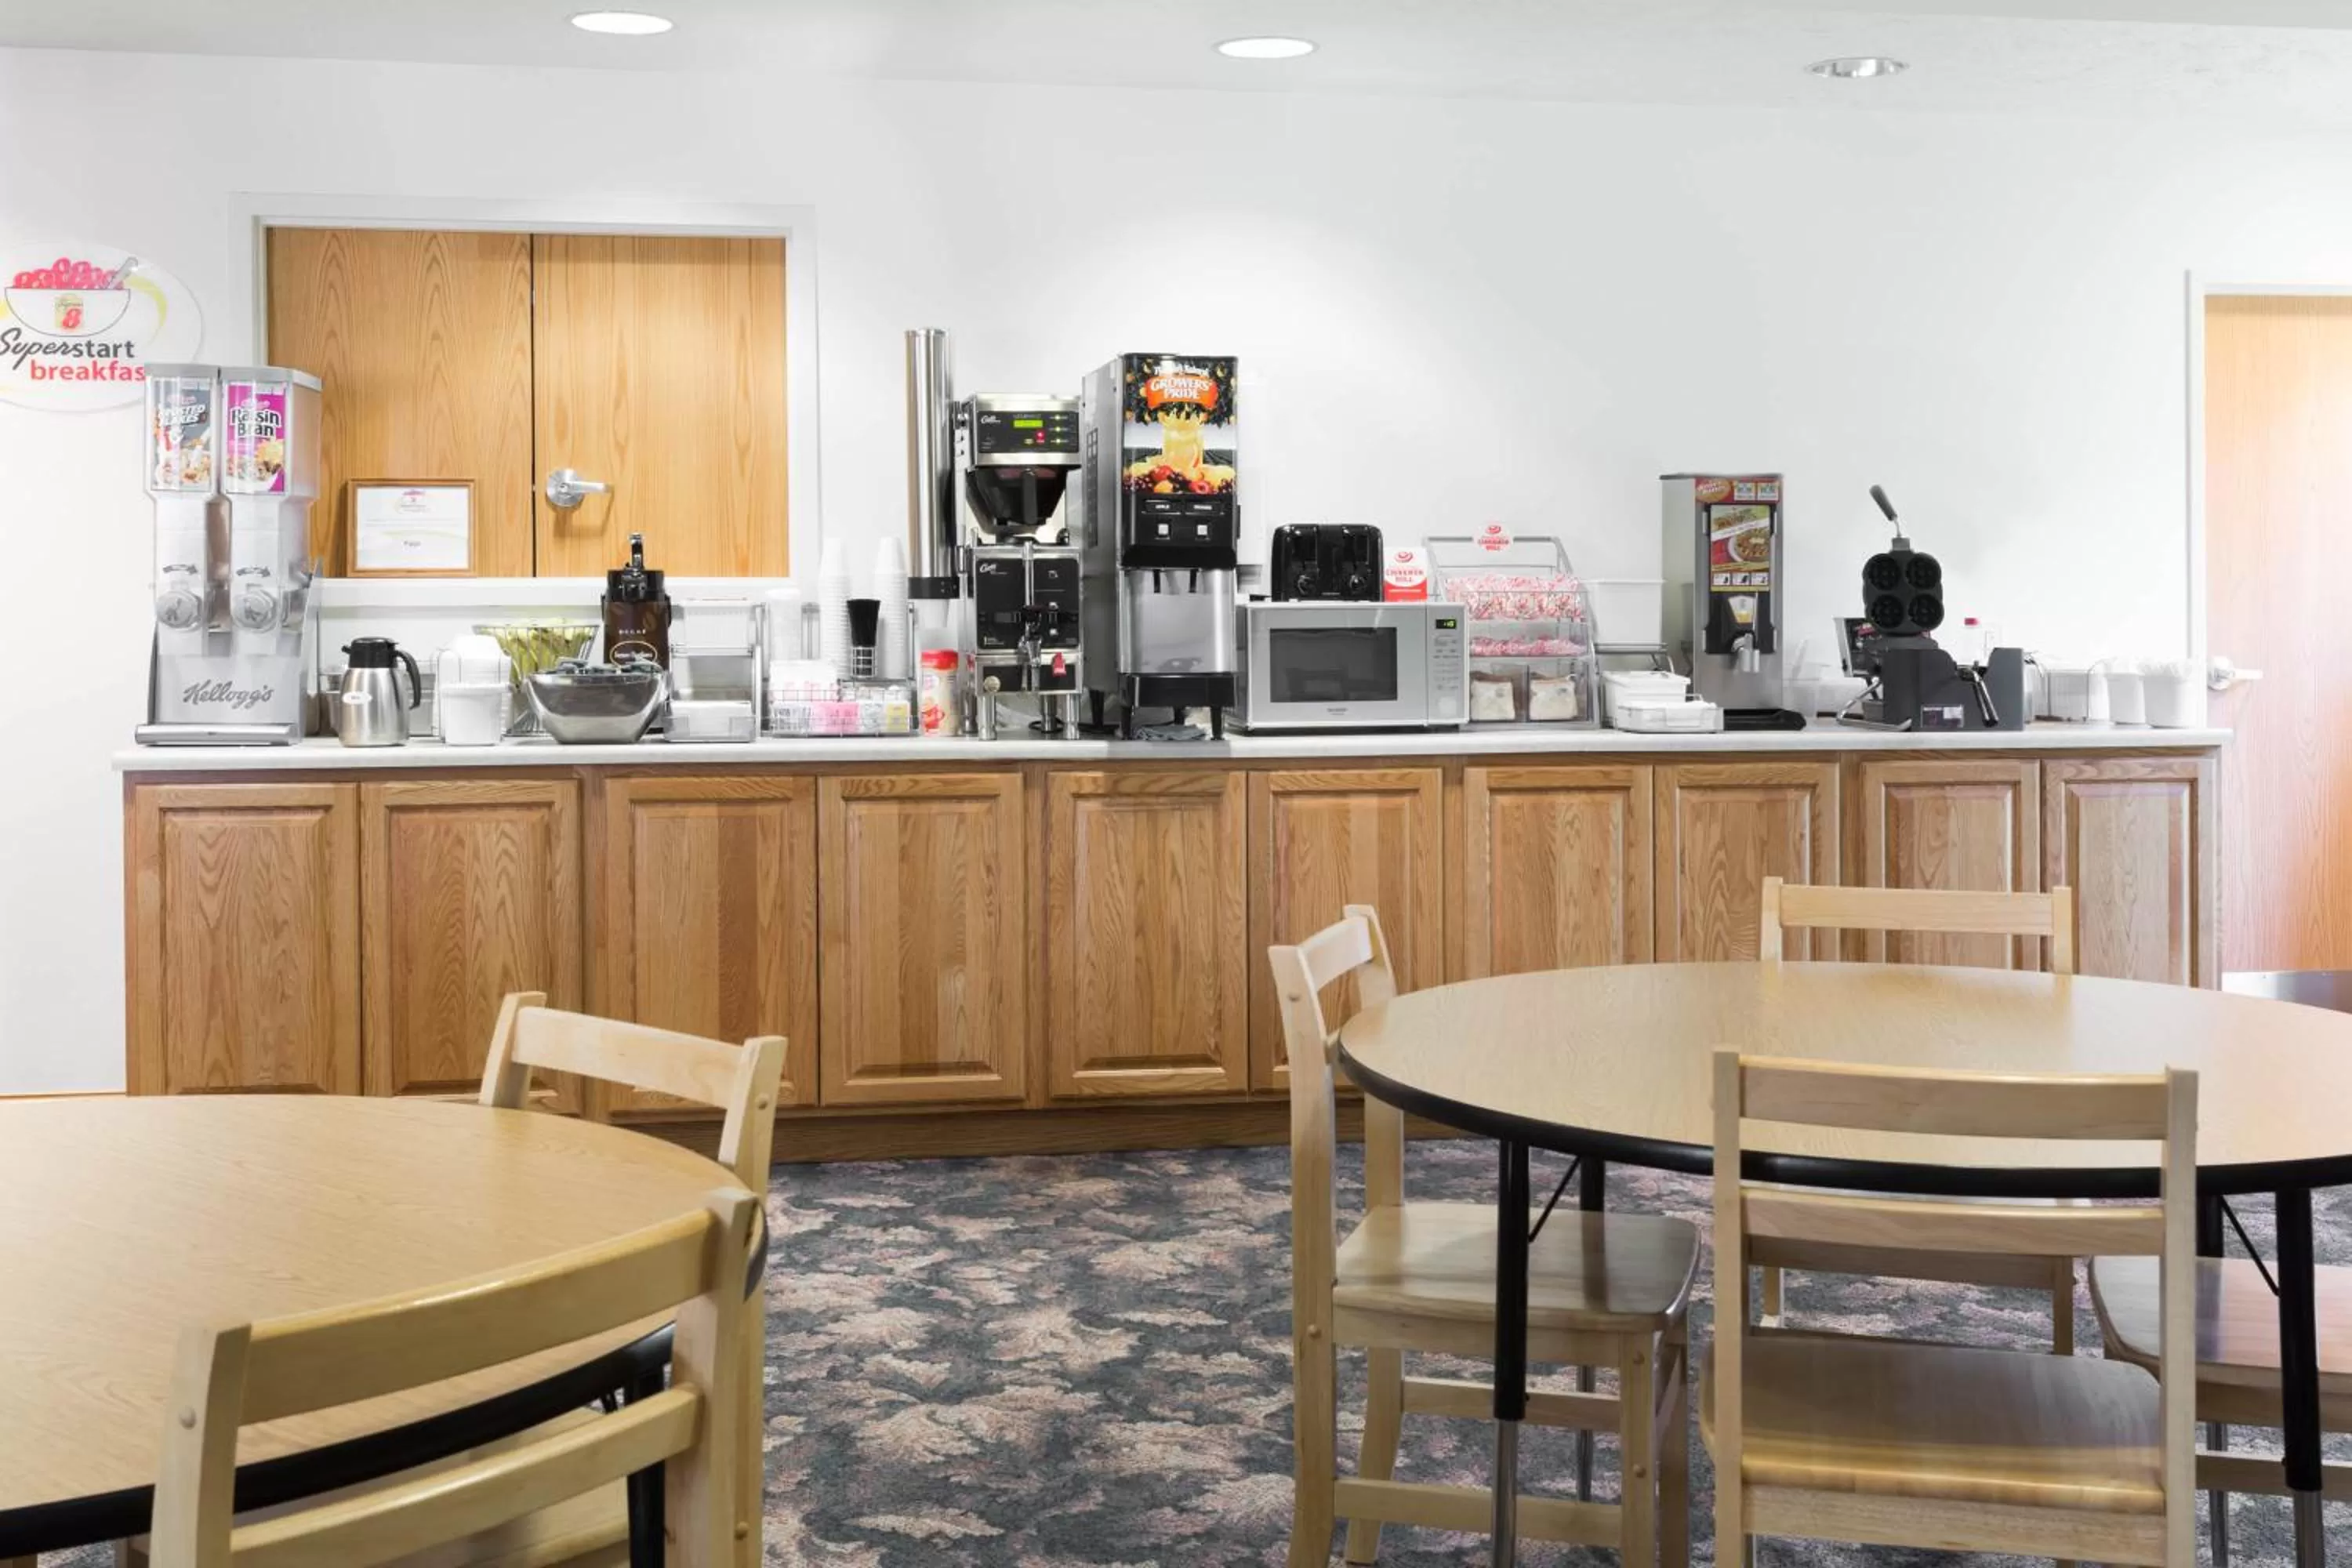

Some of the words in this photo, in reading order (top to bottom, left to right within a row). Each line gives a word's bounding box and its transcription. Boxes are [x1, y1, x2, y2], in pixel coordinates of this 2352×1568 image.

[0, 327, 135, 370] Superstart
[30, 359, 146, 381] breakfas
[231, 408, 280, 426] Rasin
[183, 679, 274, 710] Kellogg's
